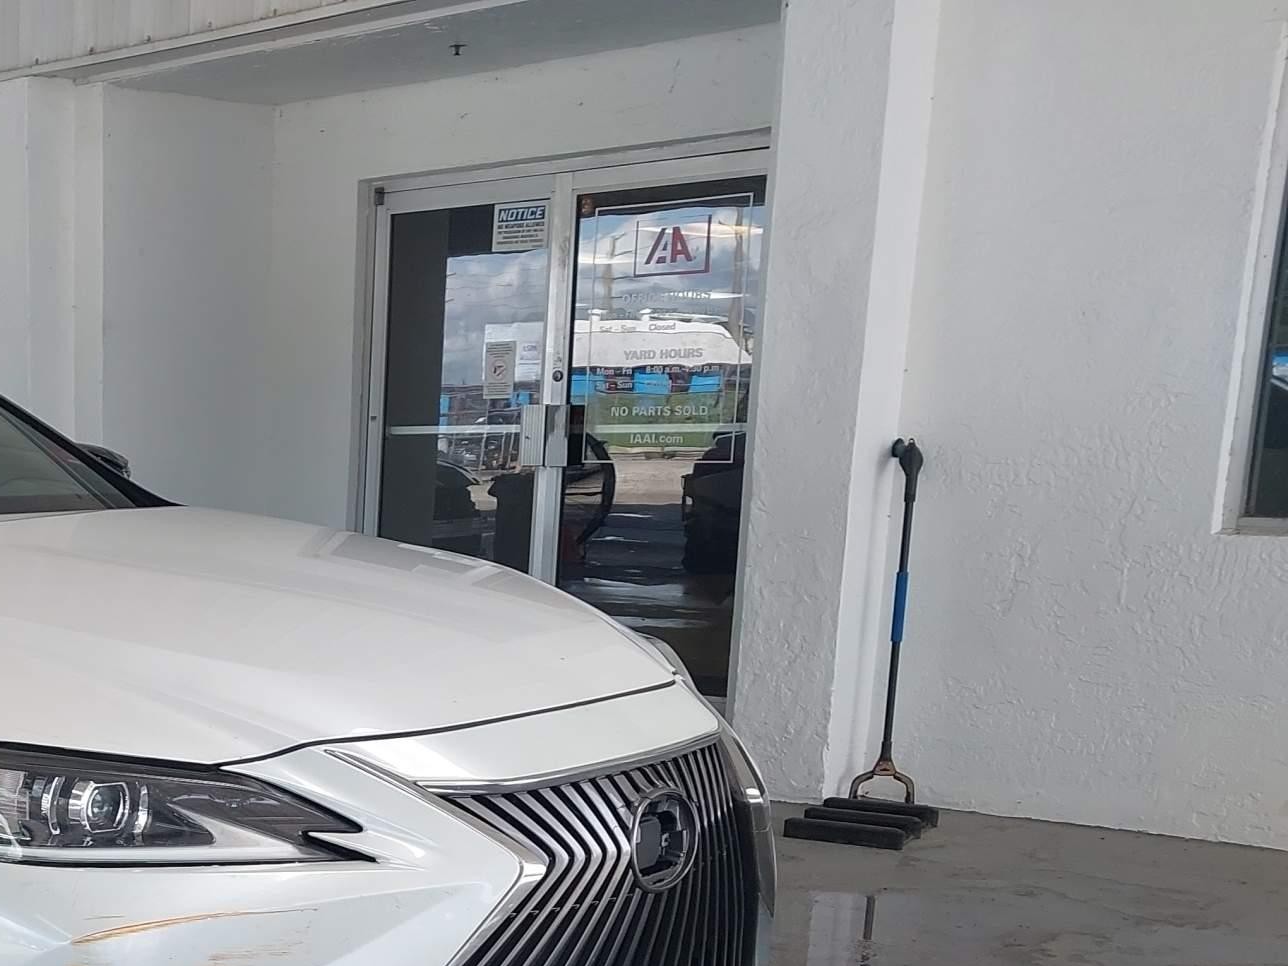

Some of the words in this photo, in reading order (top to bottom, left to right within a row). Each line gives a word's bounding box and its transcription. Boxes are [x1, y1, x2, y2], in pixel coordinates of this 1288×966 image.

[499, 207, 545, 221] NOTICE
[624, 349, 656, 360] YARD
[660, 348, 704, 359] HOURS
[597, 367, 615, 375] Mon
[610, 406, 629, 417] NO
[632, 406, 671, 417] PARTS
[674, 405, 709, 416] SOLD
[630, 433, 684, 444] IAAI.com
